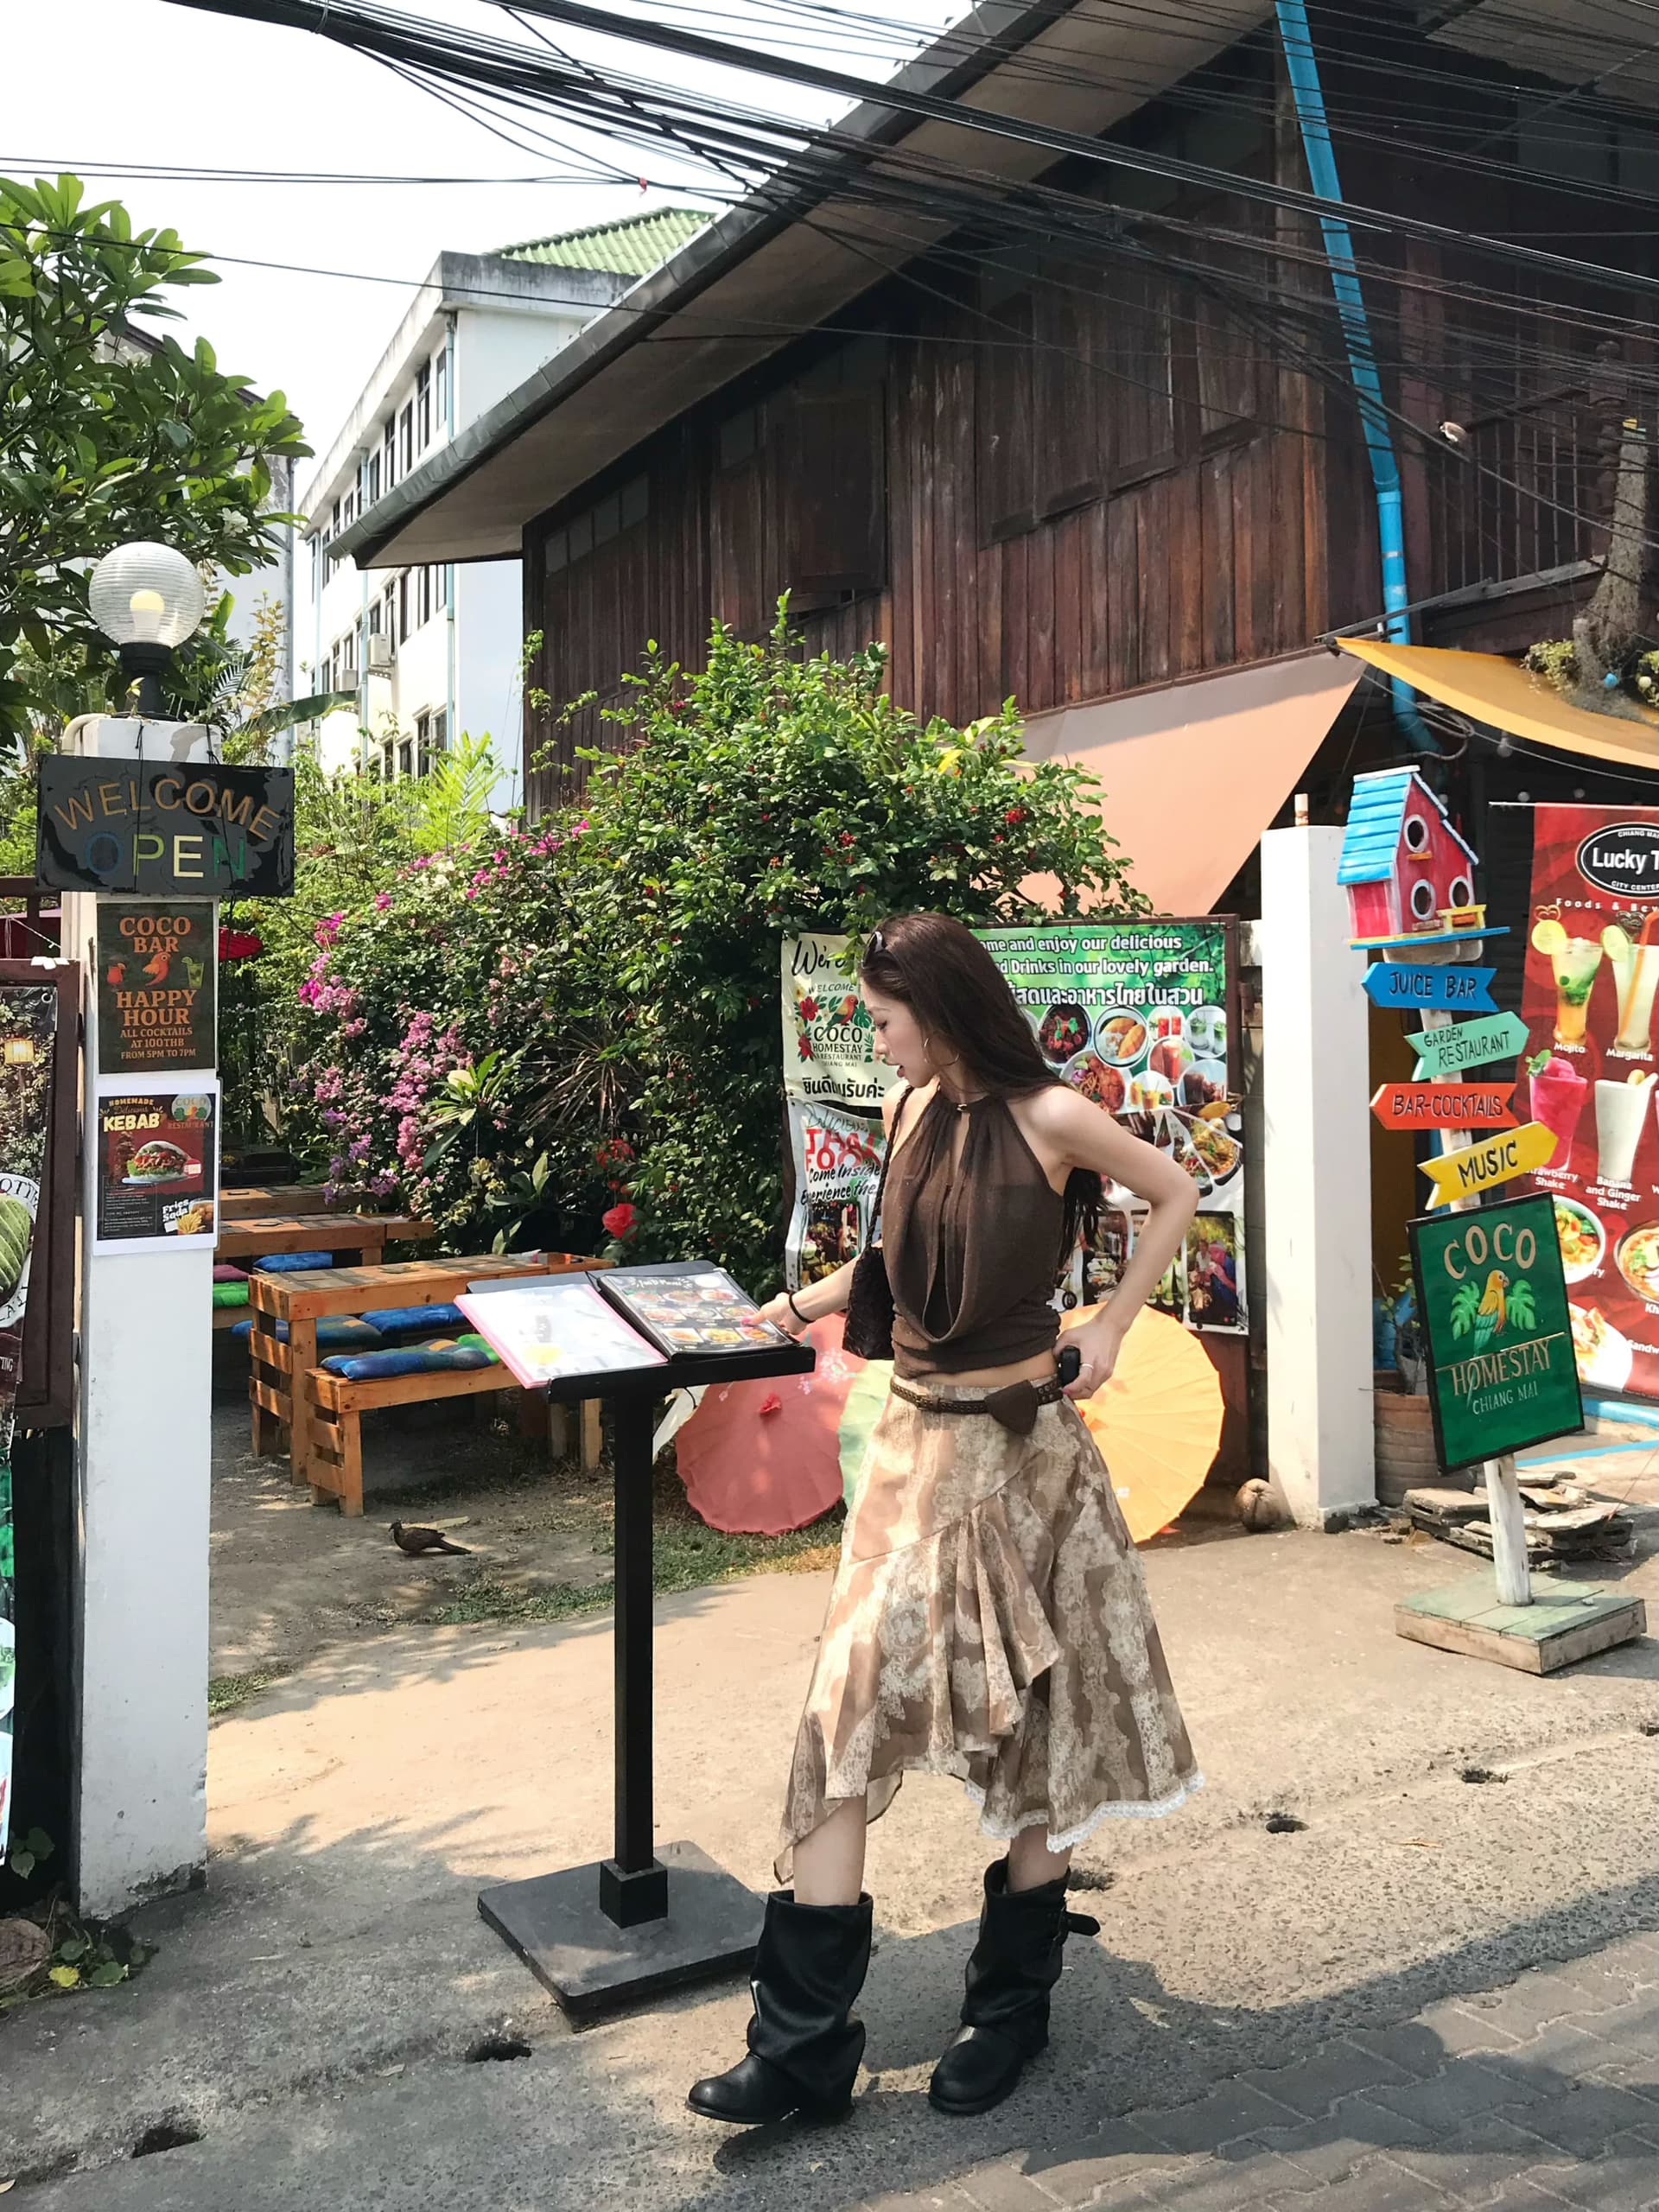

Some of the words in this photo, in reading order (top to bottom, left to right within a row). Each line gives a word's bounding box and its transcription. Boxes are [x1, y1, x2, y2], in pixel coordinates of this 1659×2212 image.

[54, 779, 281, 842] WELCOME
[88, 830, 246, 878] OPEN
[1592, 847, 1648, 875] Lucky
[1611, 880, 1629, 889] CITY
[1555, 898, 1601, 910] Foods
[1611, 901, 1620, 910] &
[1630, 903, 1659, 912] Bev
[119, 917, 192, 936] COCO
[133, 937, 180, 953] BAR
[981, 940, 1006, 950] ome
[1009, 937, 1034, 950] and
[1038, 937, 1077, 954] enjoy
[1082, 938, 1107, 950] our
[1111, 934, 1182, 950] delicious
[1011, 958, 1055, 974] Drinks
[1058, 957, 1071, 974] in
[1076, 961, 1099, 974] our
[1102, 958, 1150, 976] lovely
[1154, 958, 1214, 977] garden.
[809, 983, 855, 994] WELCOME
[1389, 971, 1433, 996] JUICE
[1445, 976, 1477, 999] BAR
[117, 989, 197, 1008] HAPPY
[123, 1007, 190, 1026] HOUR
[140, 1027, 193, 1037] COCKTAILS
[814, 1027, 862, 1043] COCO
[1423, 1027, 1464, 1047] GARDEN
[131, 1039, 143, 1048] AT
[813, 1043, 862, 1053] HOMESTAY
[1438, 1031, 1510, 1068] RESTAURANT
[1554, 1042, 1586, 1053] Mojito
[1605, 1048, 1654, 1061] Margarita
[121, 1051, 144, 1059] FROM
[179, 1048, 196, 1057] 7PM
[109, 1097, 154, 1106] HOMEMADE
[175, 1096, 207, 1106] COCO
[1392, 1093, 1503, 1117] BAR-COCKTAILS
[103, 1113, 161, 1132] KEBAB
[838, 1162, 880, 1179] Inside
[1458, 1141, 1518, 1187] MUSIC
[1529, 1167, 1579, 1182] trawberry
[1535, 1176, 1566, 1189] Shake
[1597, 1175, 1632, 1190] Banana
[854, 1179, 876, 1196] the
[1586, 1186, 1605, 1196] and
[1607, 1188, 1641, 1202] Ginger
[162, 1199, 190, 1214] Fries
[1597, 1197, 1628, 1210] Shake
[162, 1207, 188, 1222] Soda
[1444, 1223, 1536, 1279] COCO
[1628, 1339, 1659, 1354] Sandw
[1450, 1340, 1552, 1395] HOMESTAY
[1471, 1389, 1514, 1414] CHIANG
[1518, 1381, 1539, 1402] MAI
